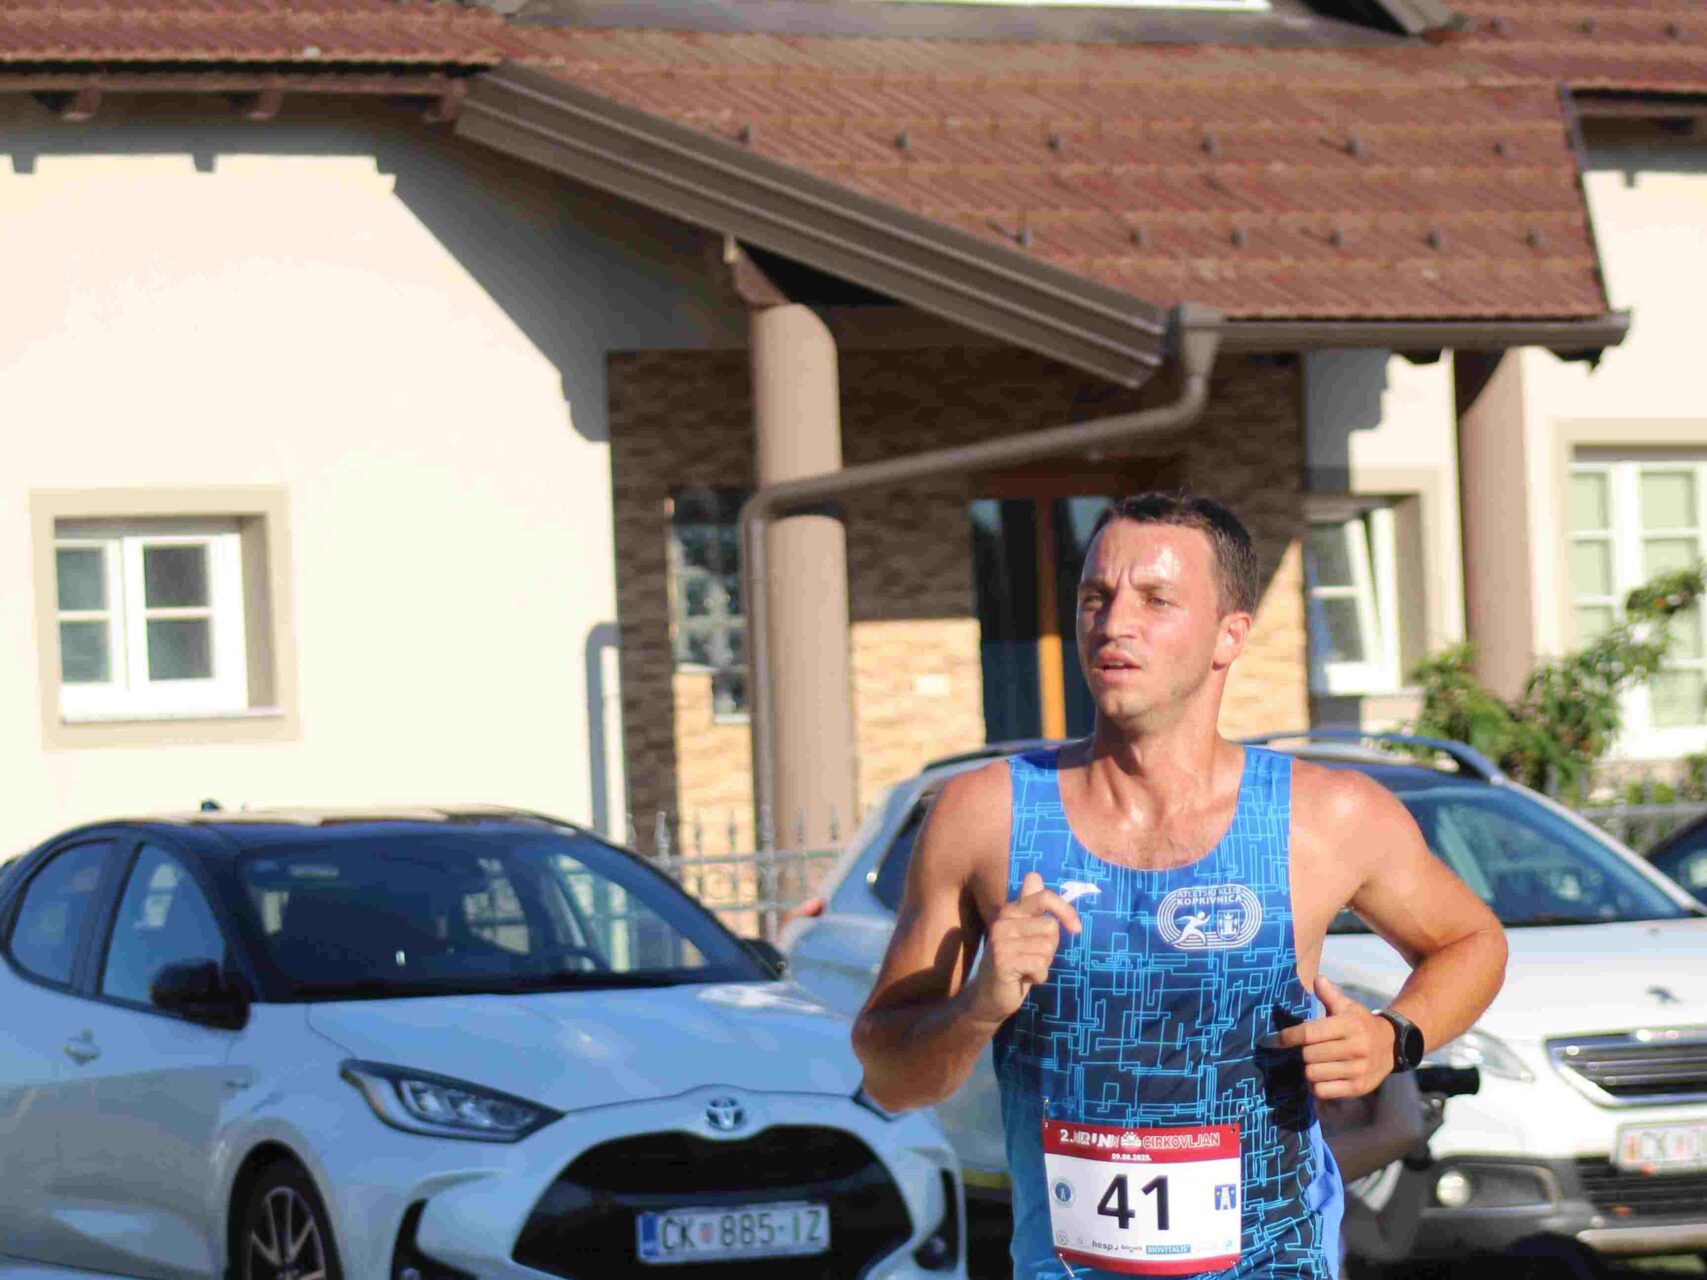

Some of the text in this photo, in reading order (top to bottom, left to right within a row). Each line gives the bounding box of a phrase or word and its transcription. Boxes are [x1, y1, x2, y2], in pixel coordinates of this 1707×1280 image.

[1176, 894, 1242, 906] KOPRIVNICA
[1142, 1132, 1220, 1149] CIRKOVLJAN
[1097, 1173, 1170, 1230] 41
